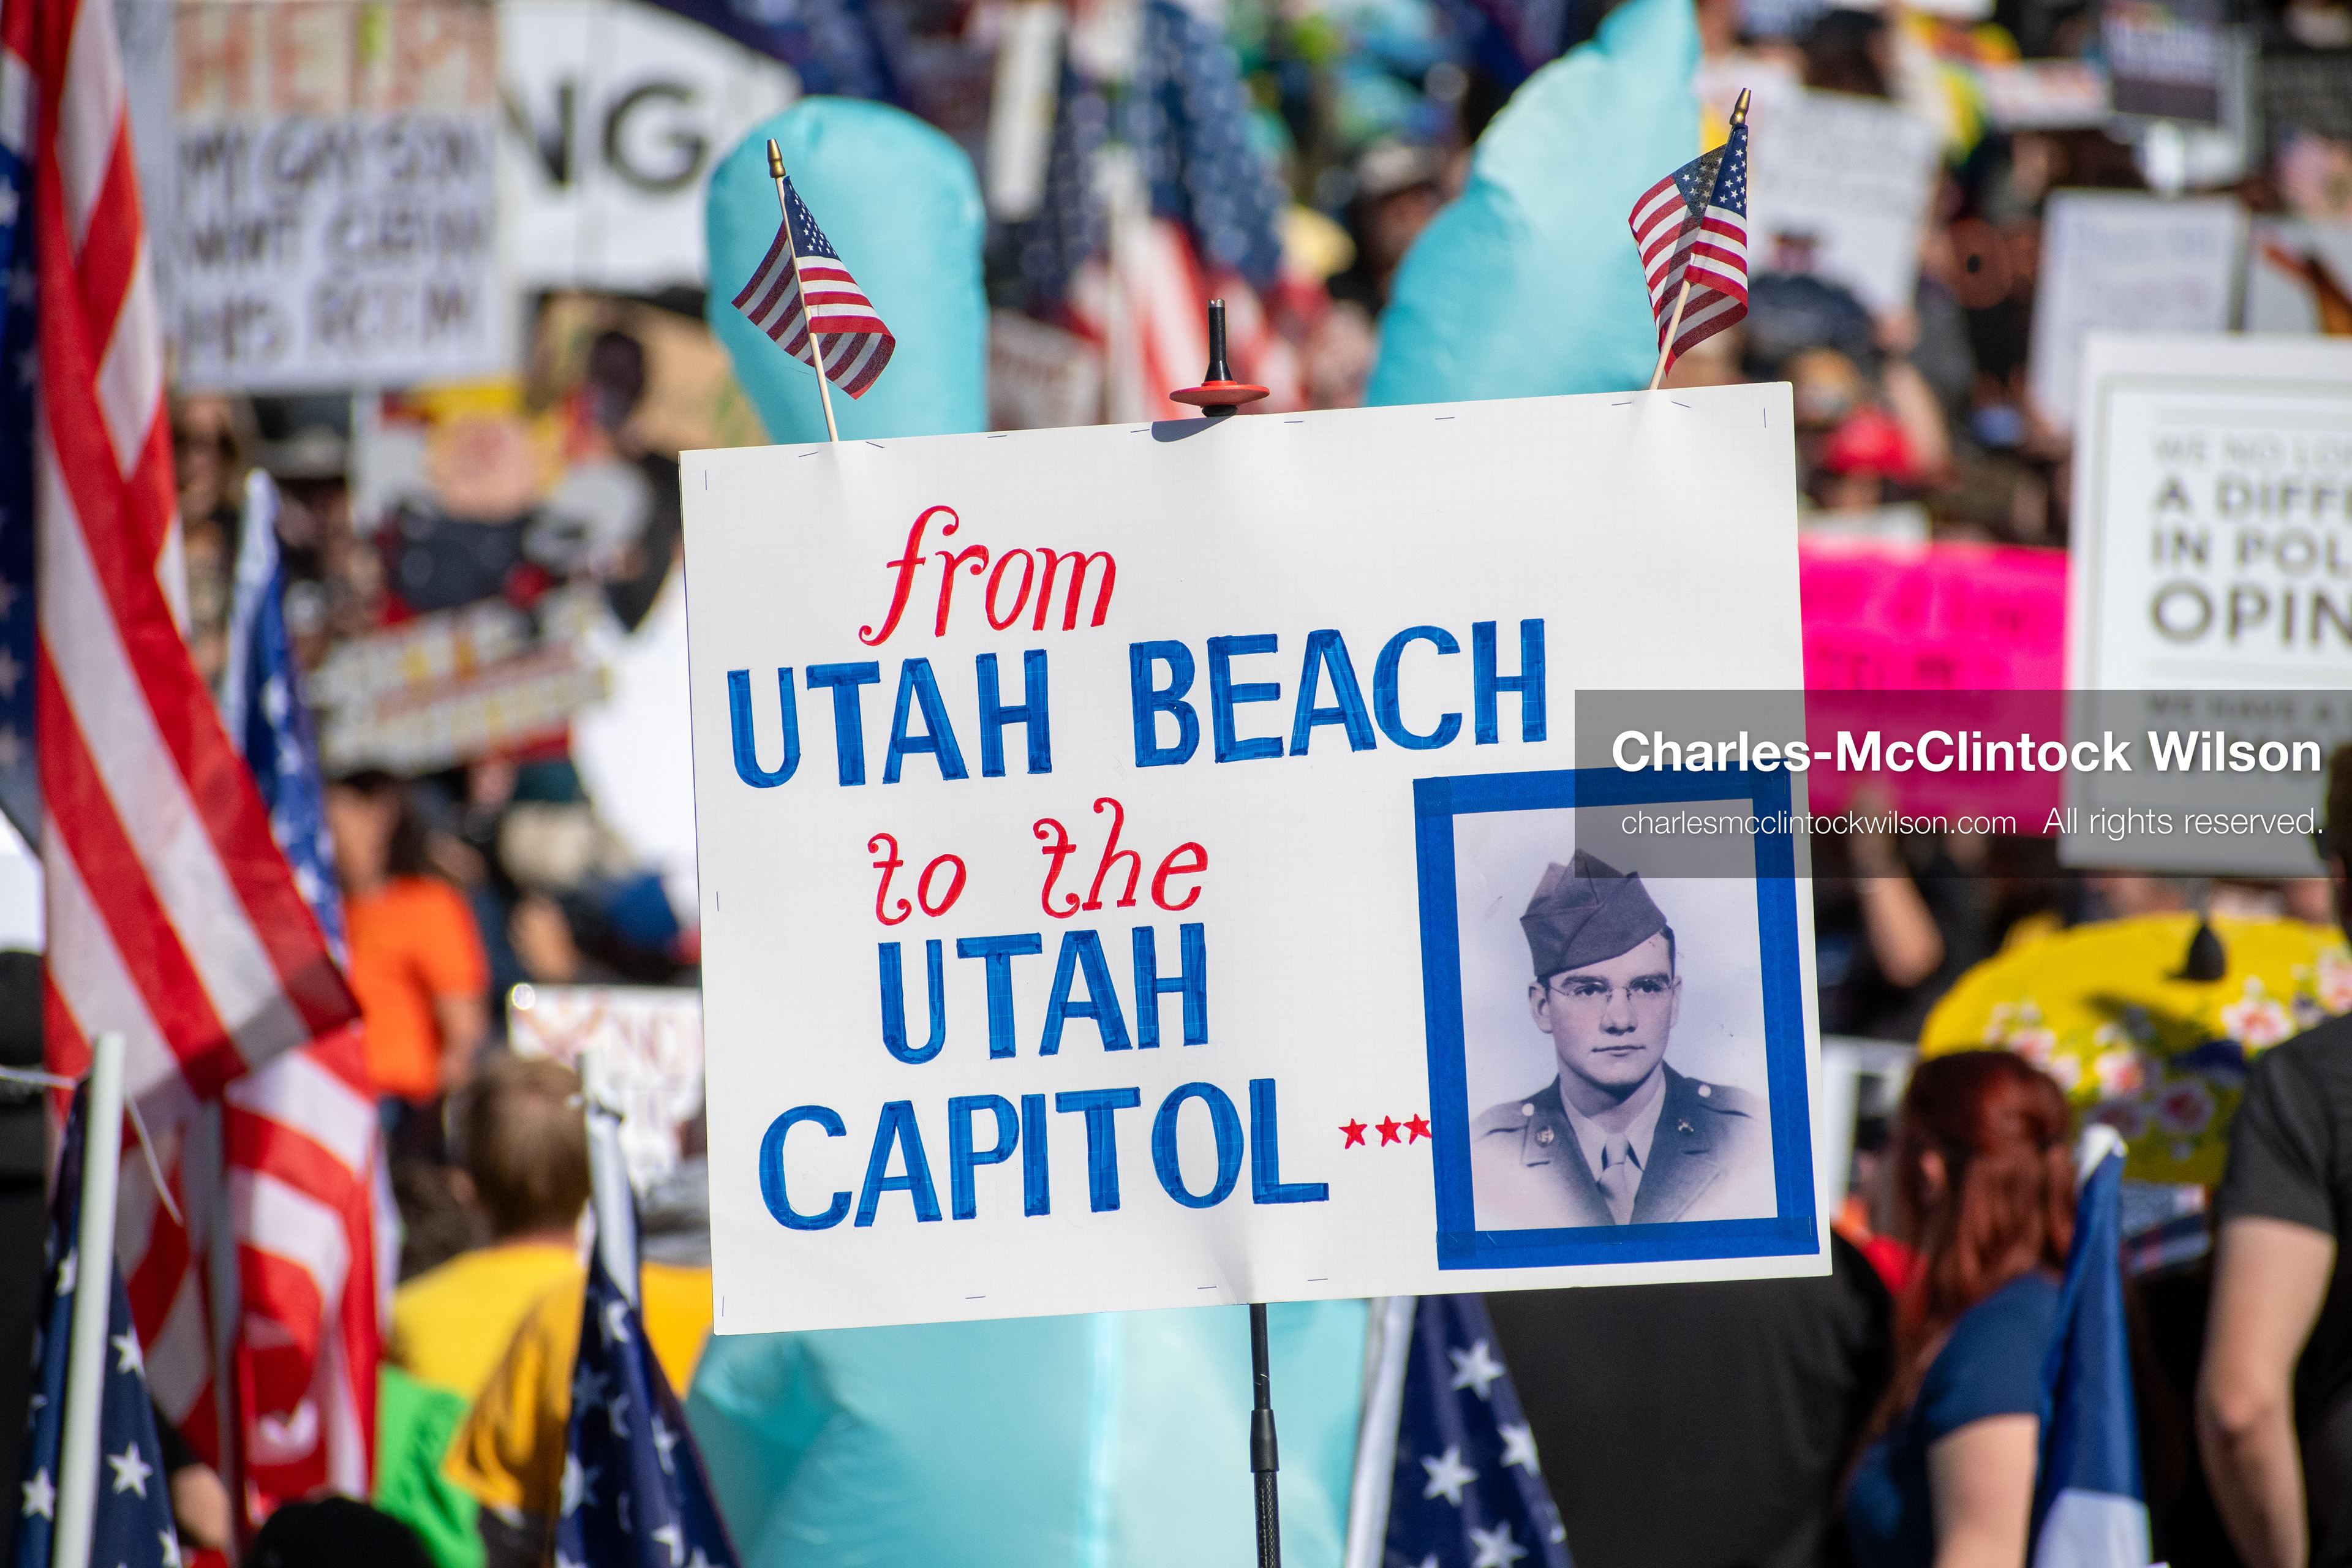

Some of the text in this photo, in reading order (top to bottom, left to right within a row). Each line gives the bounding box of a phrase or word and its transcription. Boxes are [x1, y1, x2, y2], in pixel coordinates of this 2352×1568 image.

[2150, 475, 2194, 513] A
[2151, 526, 2210, 570] IN
[858, 505, 1117, 647] from
[726, 648, 1053, 788] UTAH
[1129, 618, 1547, 768] BEACH
[867, 797, 1208, 926] to the
[877, 922, 1209, 1065] UTAH
[758, 1078, 1330, 1231] CAPITOL
